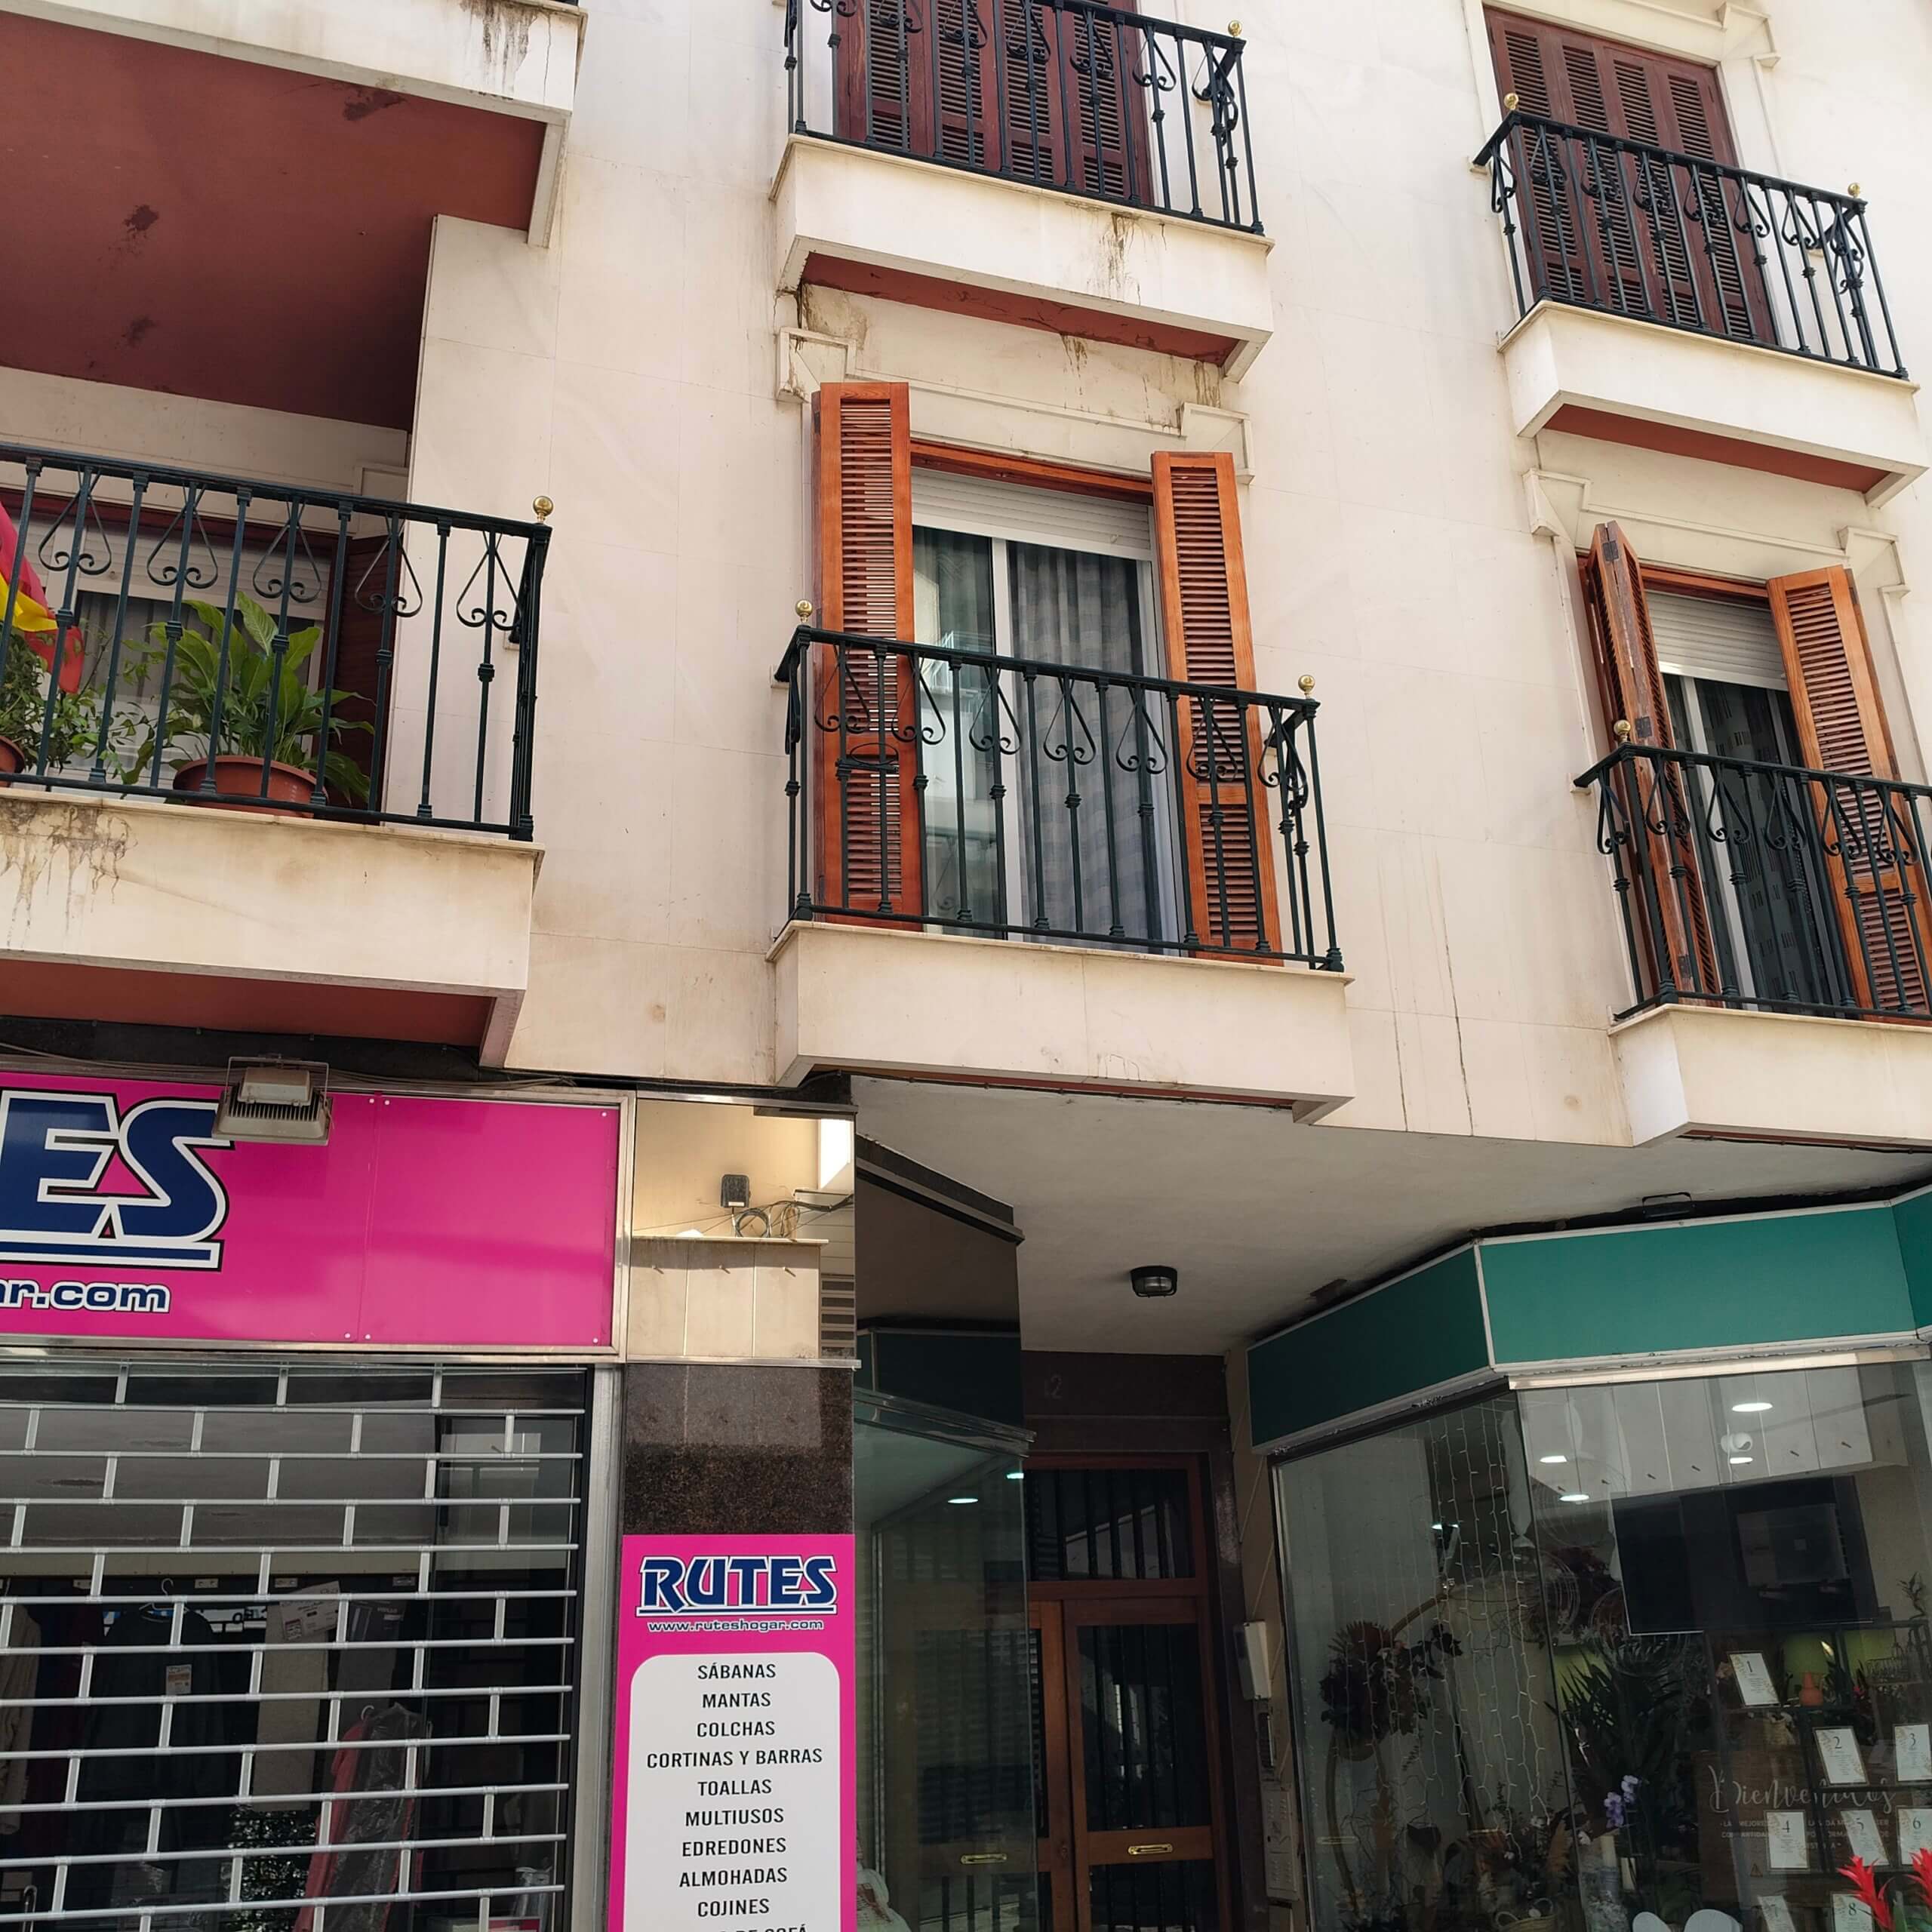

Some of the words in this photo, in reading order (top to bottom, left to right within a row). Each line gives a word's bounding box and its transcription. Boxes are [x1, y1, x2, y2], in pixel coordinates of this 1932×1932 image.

[0, 1278, 171, 1313] r.com
[639, 1554, 838, 1613] RUTES
[647, 1617, 825, 1632] www.ruteshogar.com
[697, 1662, 776, 1680] SÁBANAS
[702, 1692, 771, 1709] MANTAS
[697, 1721, 775, 1737] COLCHAS
[1832, 1736, 1842, 1749] 2
[647, 1751, 734, 1769] CORTINAS
[739, 1750, 749, 1765] Y
[755, 1748, 823, 1765] BARRAS
[697, 1779, 772, 1796] TOALLAS
[685, 1807, 784, 1827] MULTIUSOS
[1912, 1817, 1921, 1830] 6
[682, 1837, 786, 1857] EDREDONES
[679, 1867, 787, 1887] ALMOHADAS
[697, 1898, 770, 1918] COJINES
[1848, 1903, 1857, 1916] 8
